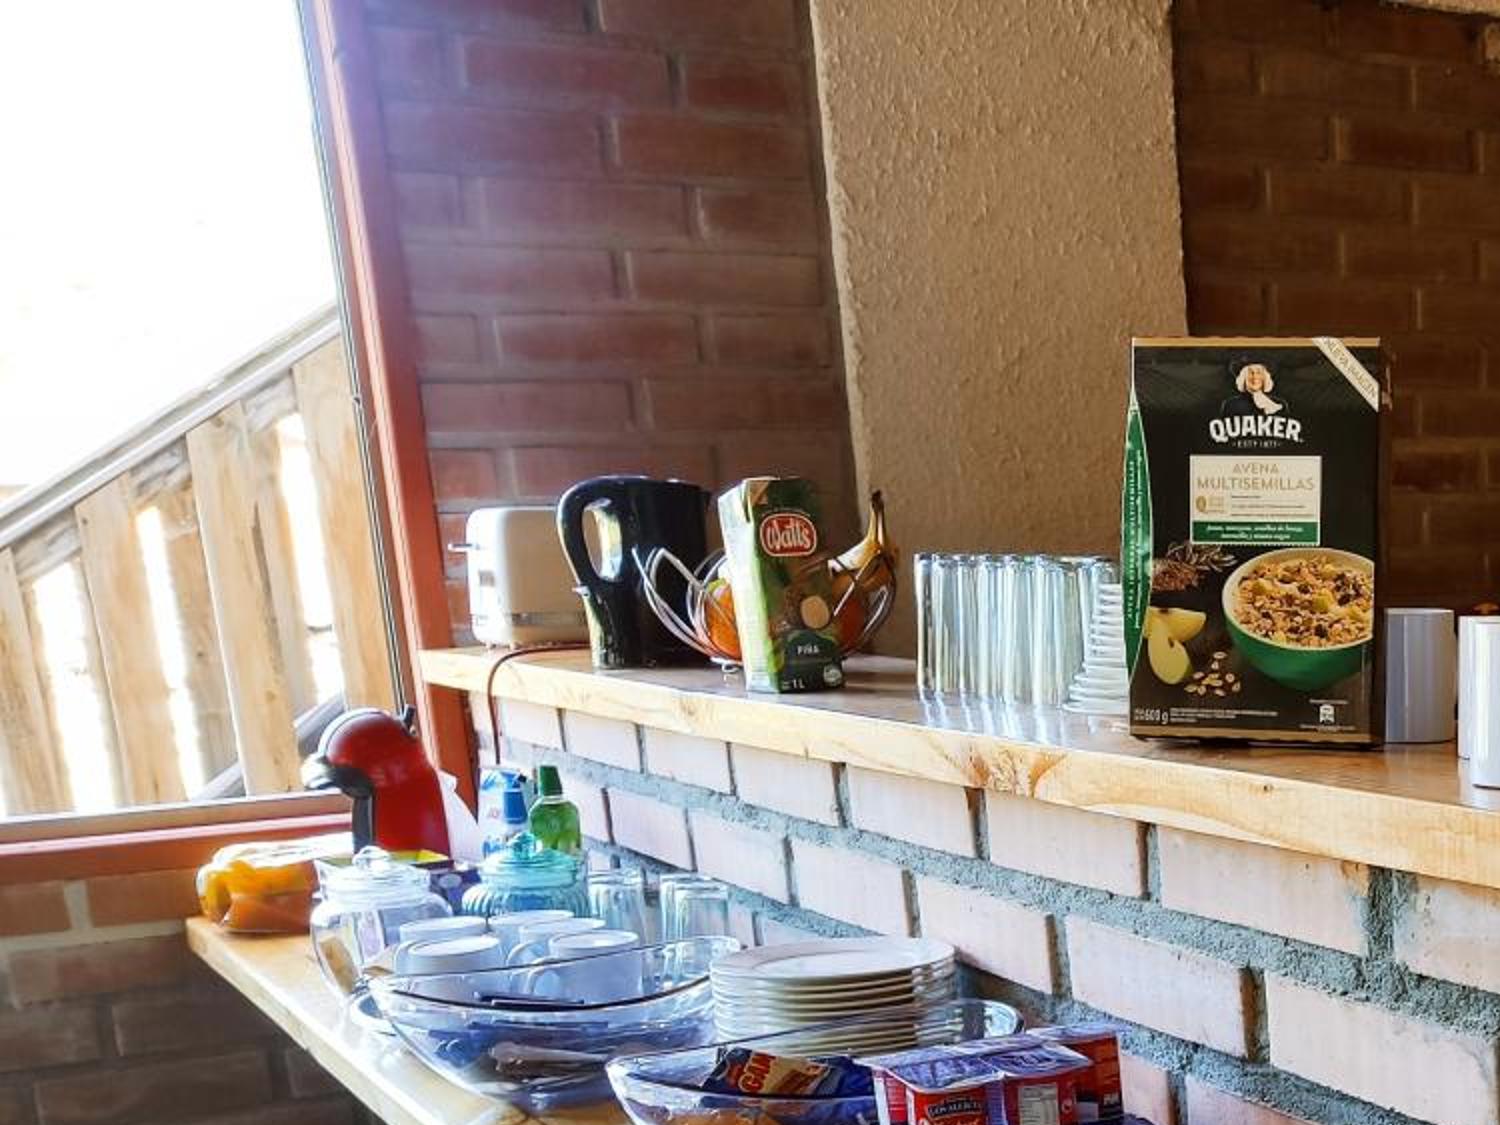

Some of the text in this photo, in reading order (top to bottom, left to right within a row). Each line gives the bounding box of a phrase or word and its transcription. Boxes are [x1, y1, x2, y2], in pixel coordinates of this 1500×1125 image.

[1208, 414, 1302, 443] QUAKER
[1232, 463, 1279, 474] AVENA
[1197, 478, 1315, 491] MULTISEMILLAS
